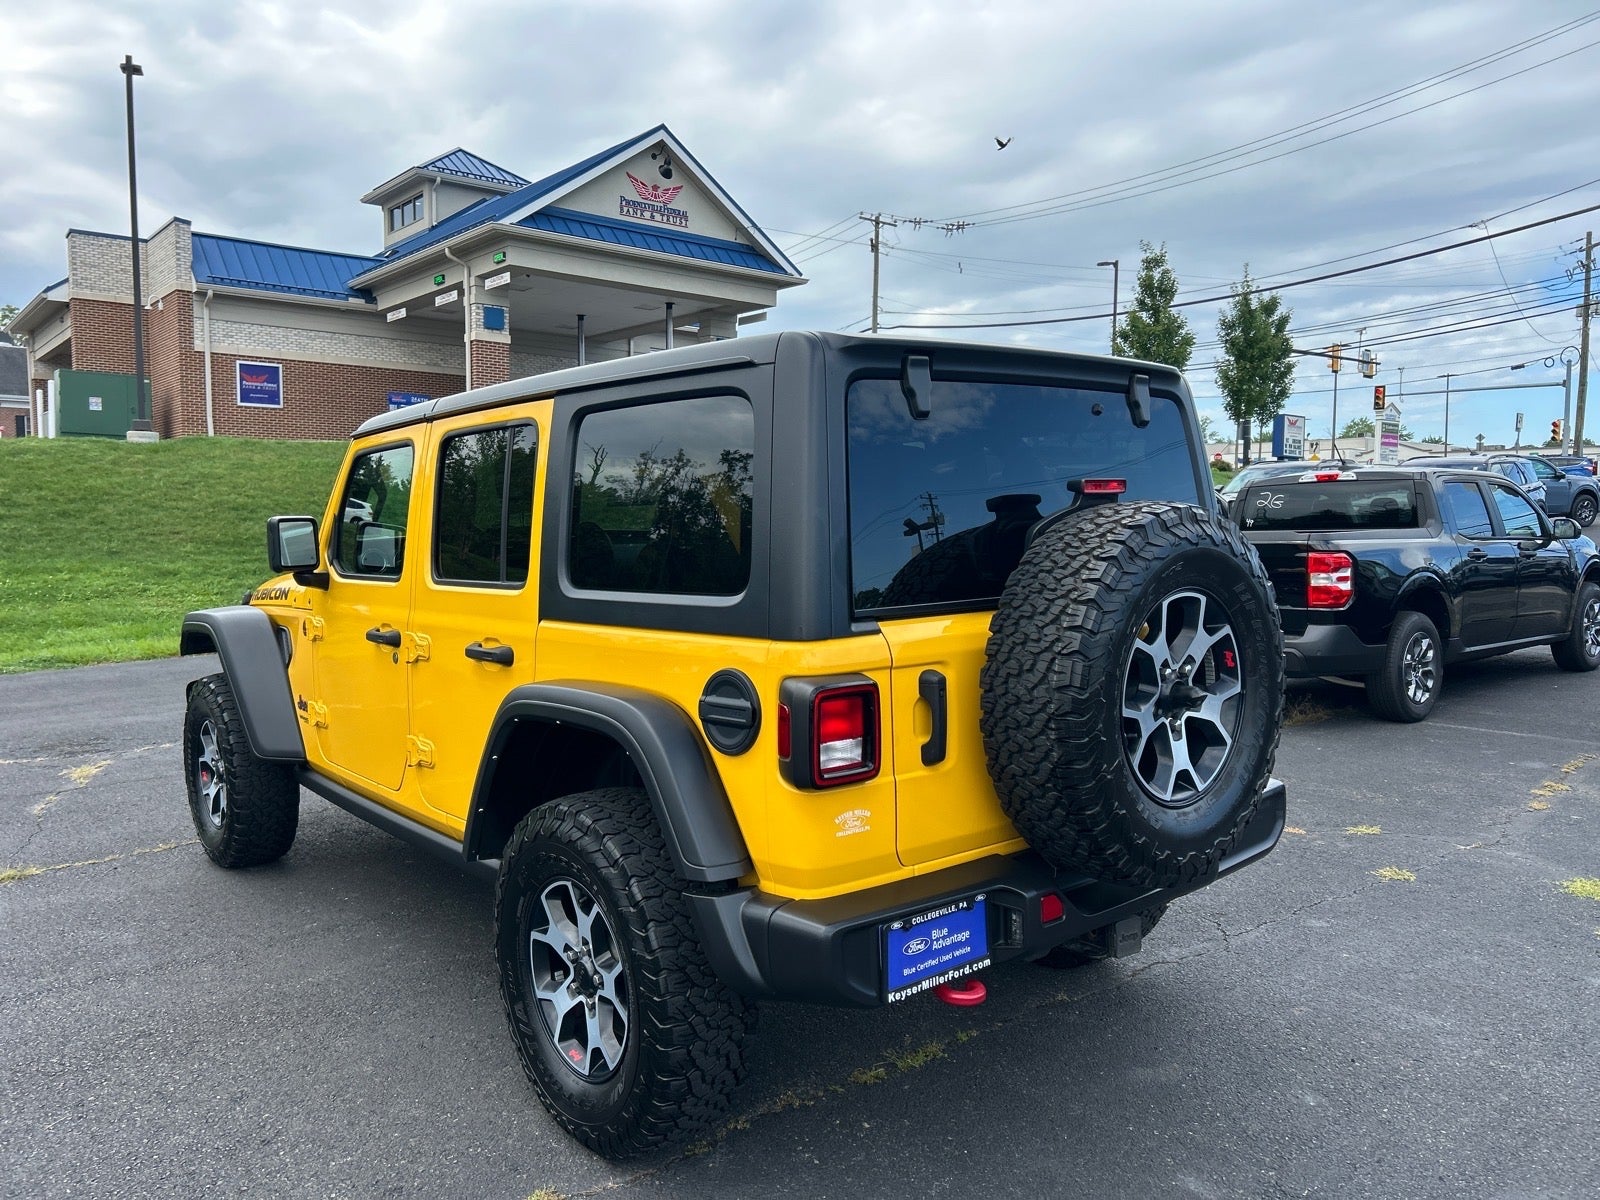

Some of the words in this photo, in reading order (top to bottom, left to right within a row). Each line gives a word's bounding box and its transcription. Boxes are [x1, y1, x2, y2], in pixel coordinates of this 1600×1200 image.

[619, 206, 646, 218] BANK
[649, 212, 656, 220] &
[660, 213, 689, 226] TRUST
[251, 587, 291, 601] RUBICON
[912, 905, 958, 925] COLLEGEVILLE,
[959, 901, 968, 911] PA
[931, 927, 949, 940] Blue
[932, 930, 971, 951] Advantage
[907, 940, 927, 953] Ford
[903, 966, 916, 977] Blue
[916, 957, 939, 972] Certified
[939, 953, 953, 963] Used
[953, 946, 971, 957] Vehicle
[888, 958, 991, 1003] KeyserMillerFord.com
